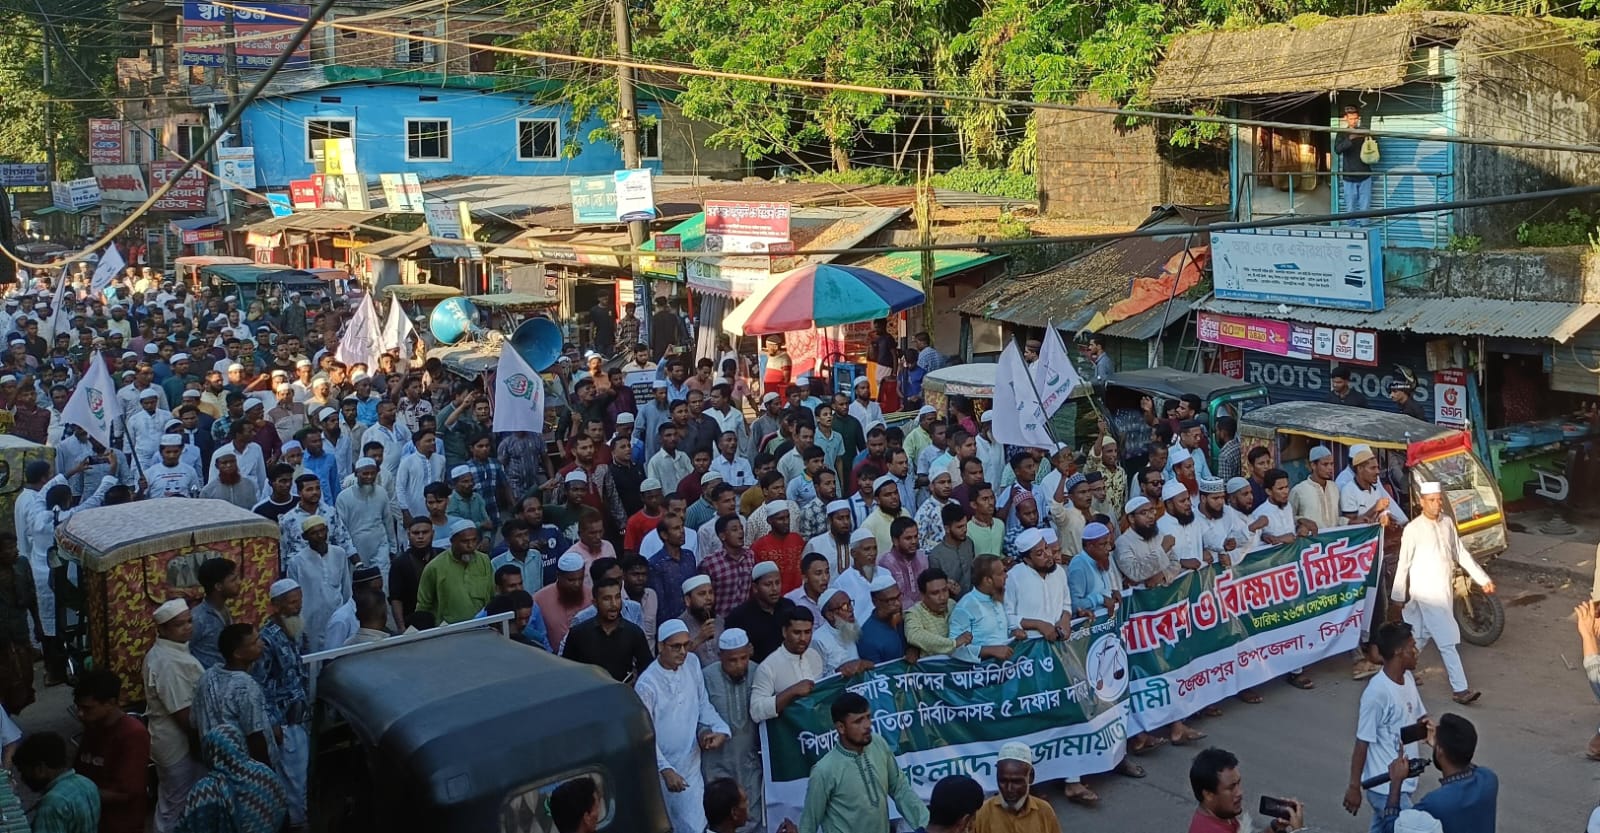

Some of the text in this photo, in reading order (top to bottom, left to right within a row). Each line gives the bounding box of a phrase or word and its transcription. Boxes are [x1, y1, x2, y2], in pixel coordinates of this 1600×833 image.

[1249, 361, 1322, 390] ROOTS
[1348, 374, 1430, 402] ROOS
[1440, 405, 1463, 418] নগদ
[1192, 590, 1218, 631] ও
[1213, 561, 1301, 624] বিক্ষোভ
[845, 655, 1055, 701] লাই সনদের আইনিভিত্তি ও
[1175, 660, 1236, 697] জৈন্তাপুর
[917, 699, 996, 728] নির্বাচনসহ
[1000, 700, 1014, 718] ৫
[1017, 689, 1062, 715] দফার
